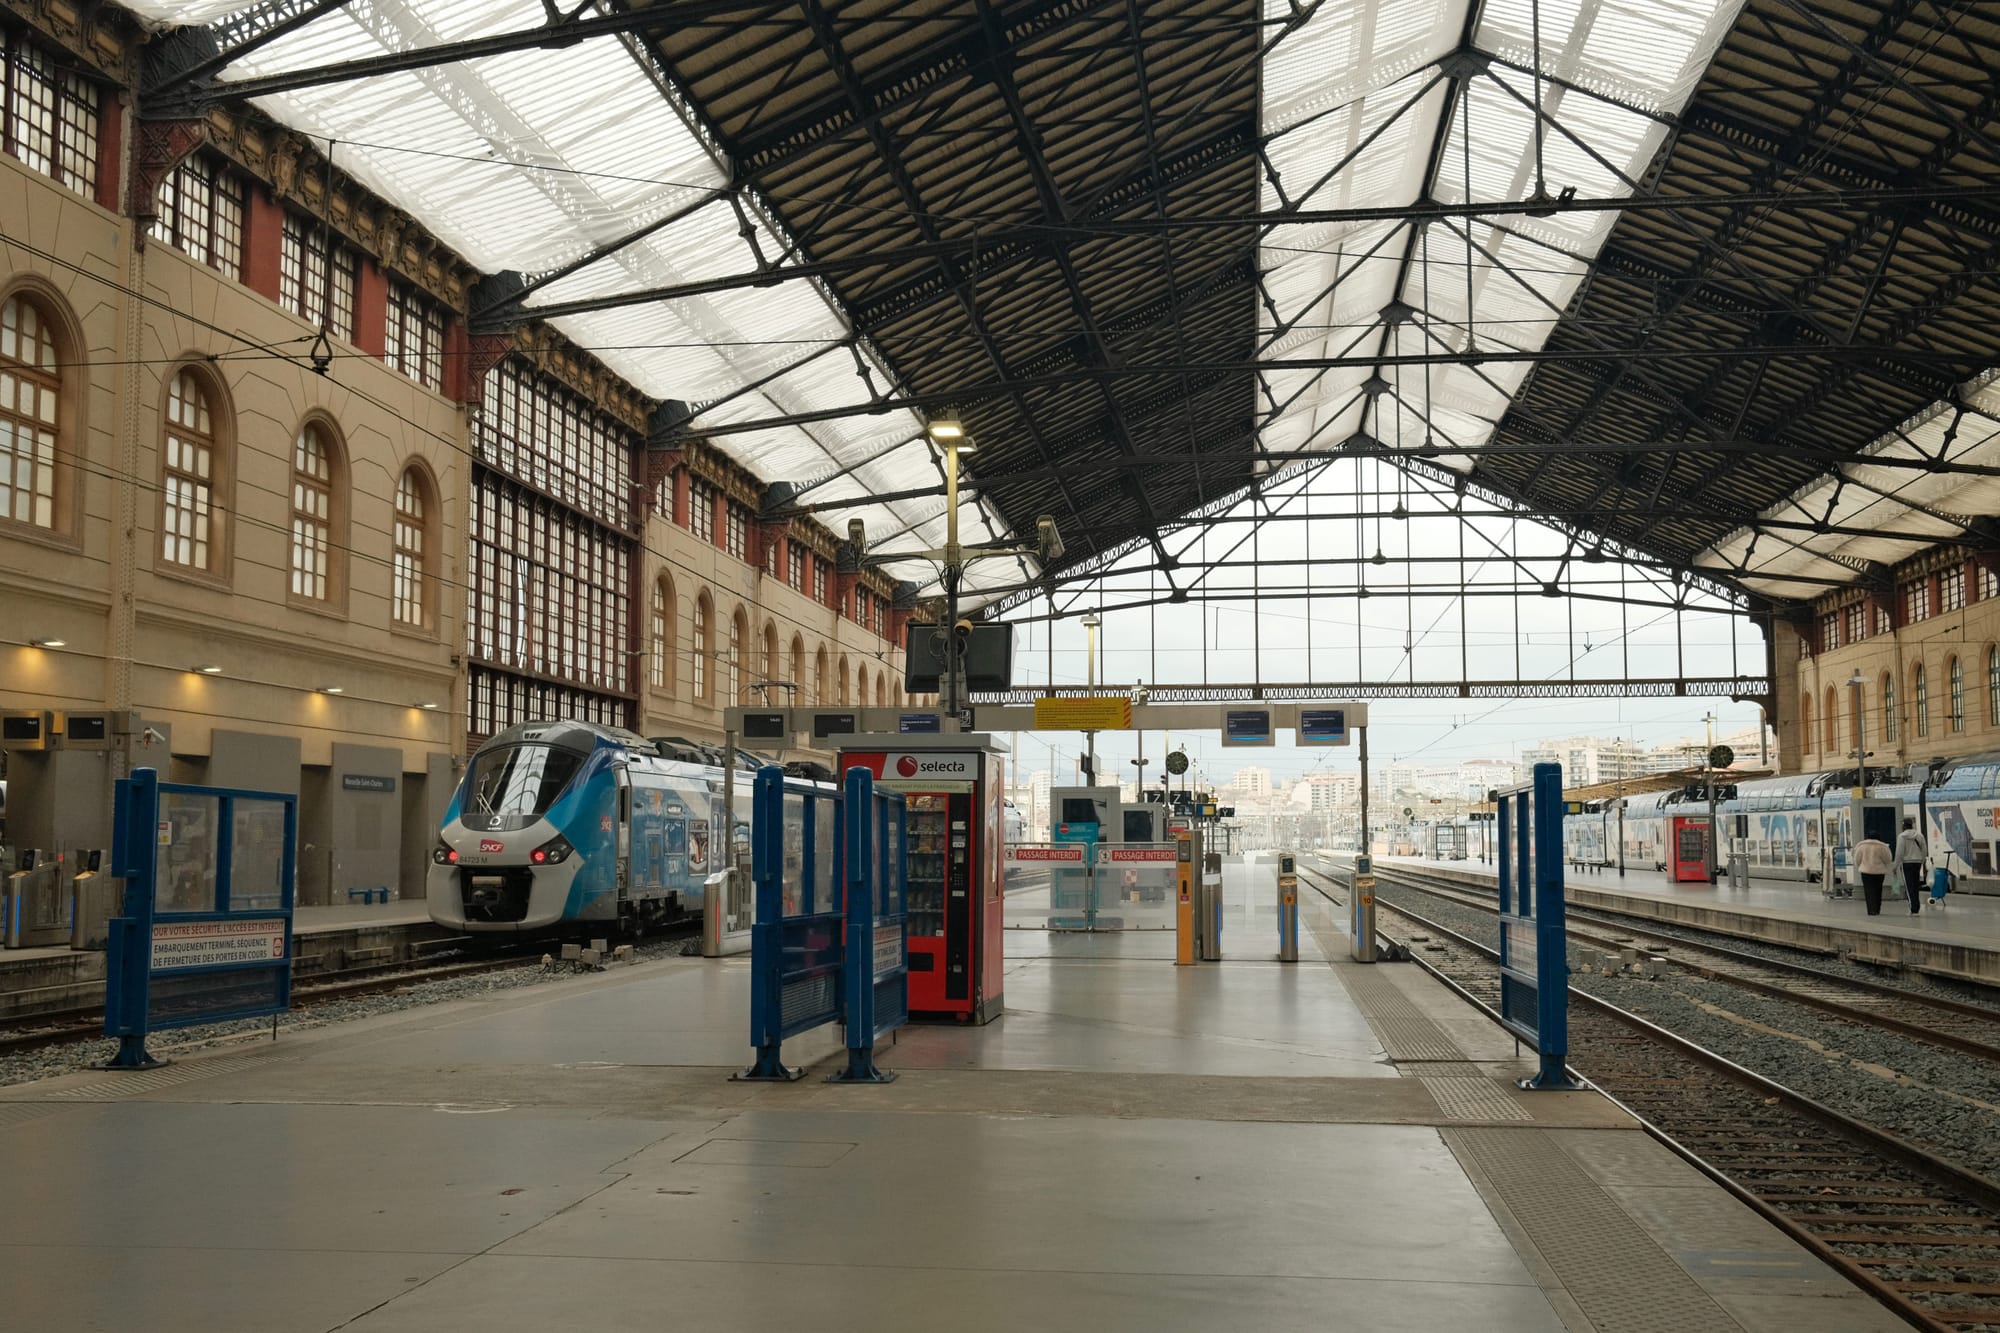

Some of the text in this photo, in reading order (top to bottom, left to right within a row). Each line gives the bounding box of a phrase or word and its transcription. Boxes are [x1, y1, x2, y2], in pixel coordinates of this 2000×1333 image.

[920, 761, 965, 772] selecta
[1153, 793, 1161, 803] Z
[1173, 793, 1181, 804] Z
[1696, 788, 1705, 800] Z
[1717, 788, 1727, 800] Z
[480, 843, 504, 852] SNCF
[1018, 850, 1081, 860] PASSAGE INTERDIT
[1114, 851, 1177, 860] PASSAGE INTERDIT
[152, 927, 168, 937] OUR
[168, 925, 191, 936] VOTRE
[191, 922, 223, 935] SÉCURITÉ,
[247, 922, 259, 932] EST
[258, 920, 285, 932] INTERDIT
[154, 937, 267, 954] EMBARQUEMENT TERMINÉ, SÉQUENCE
[153, 950, 267, 967] DE FERMETURE DES PORTES EN COURS
